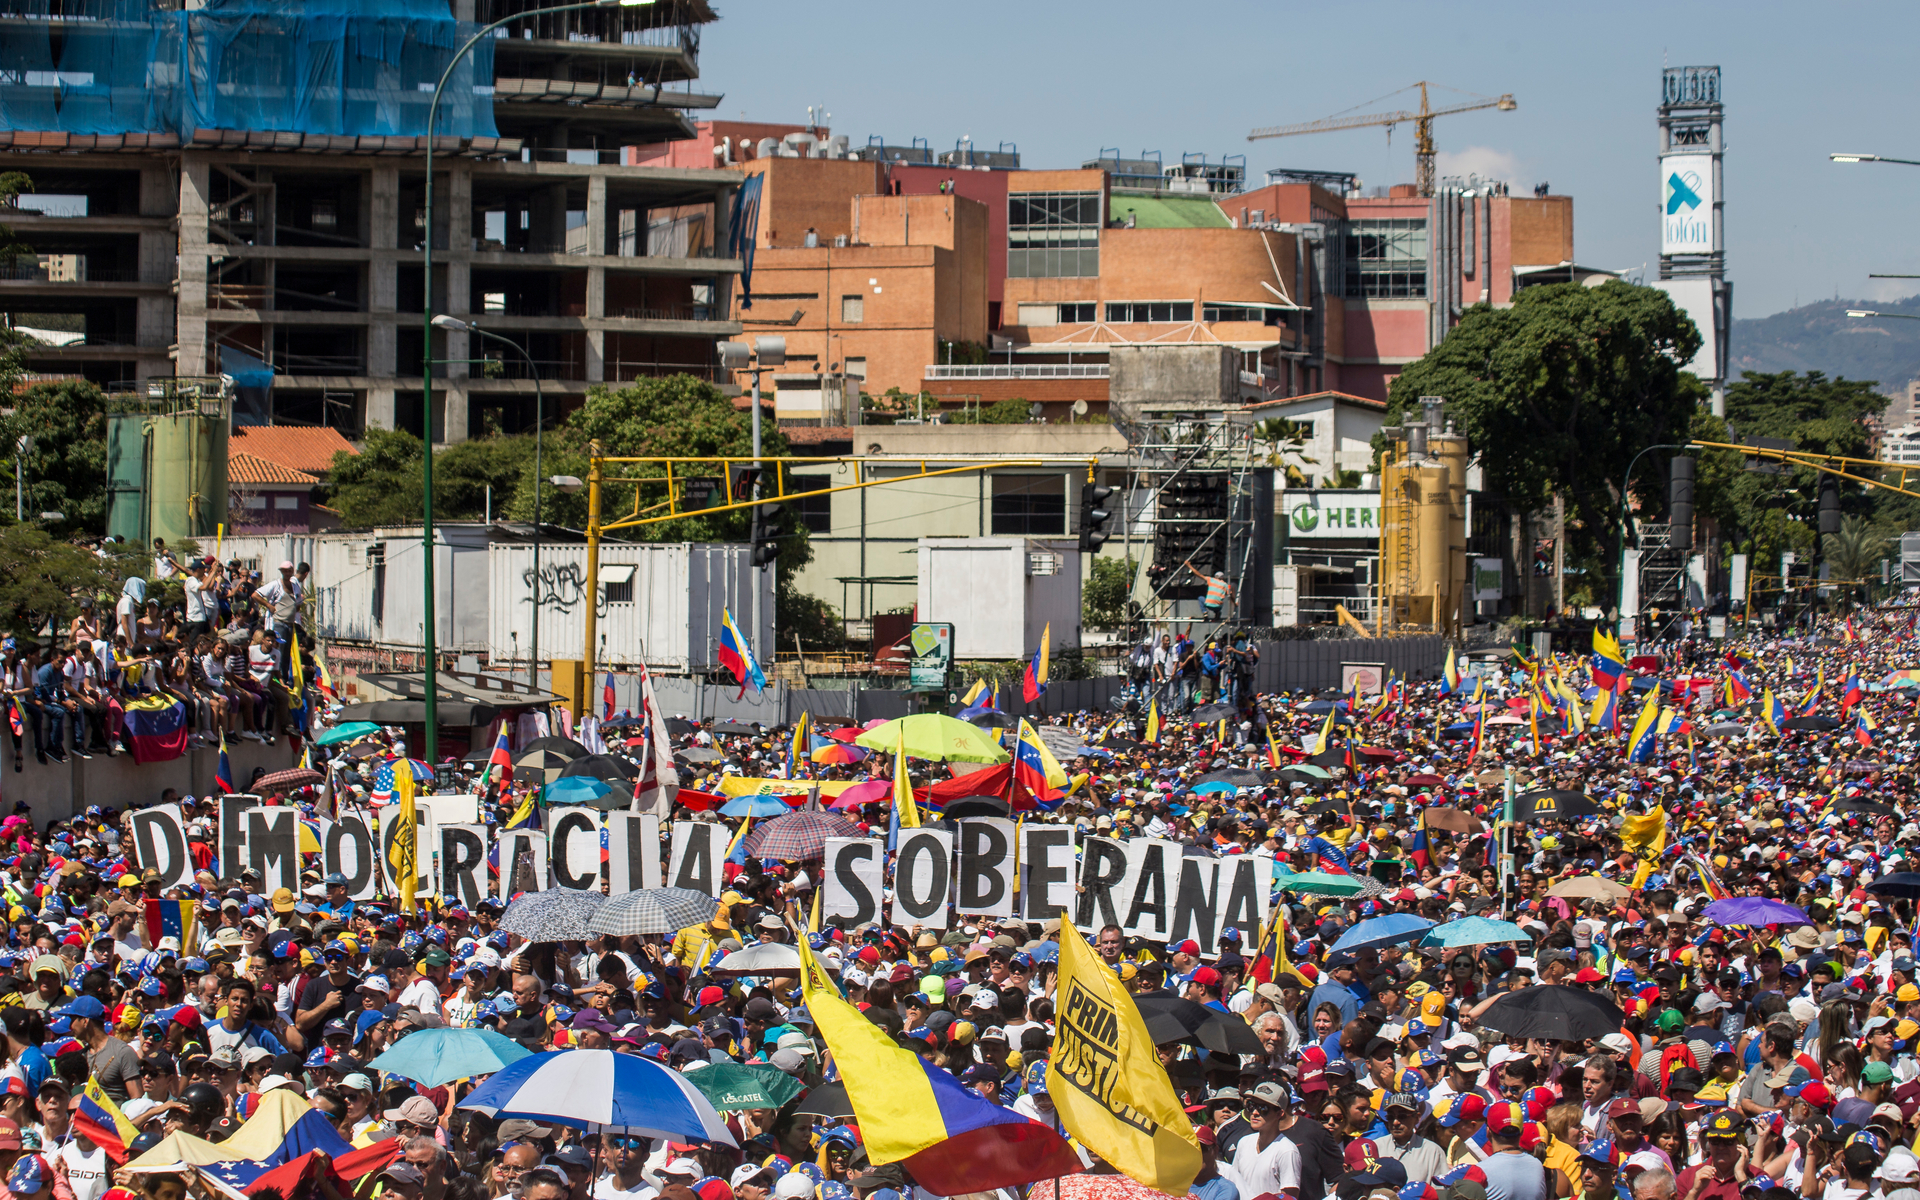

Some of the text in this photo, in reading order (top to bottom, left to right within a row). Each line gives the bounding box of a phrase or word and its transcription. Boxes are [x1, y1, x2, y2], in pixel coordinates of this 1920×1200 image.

[134, 797, 713, 911] DEMOCRACIA
[834, 821, 1260, 954] SOBERANA
[722, 1092, 764, 1104] LOCATEL
